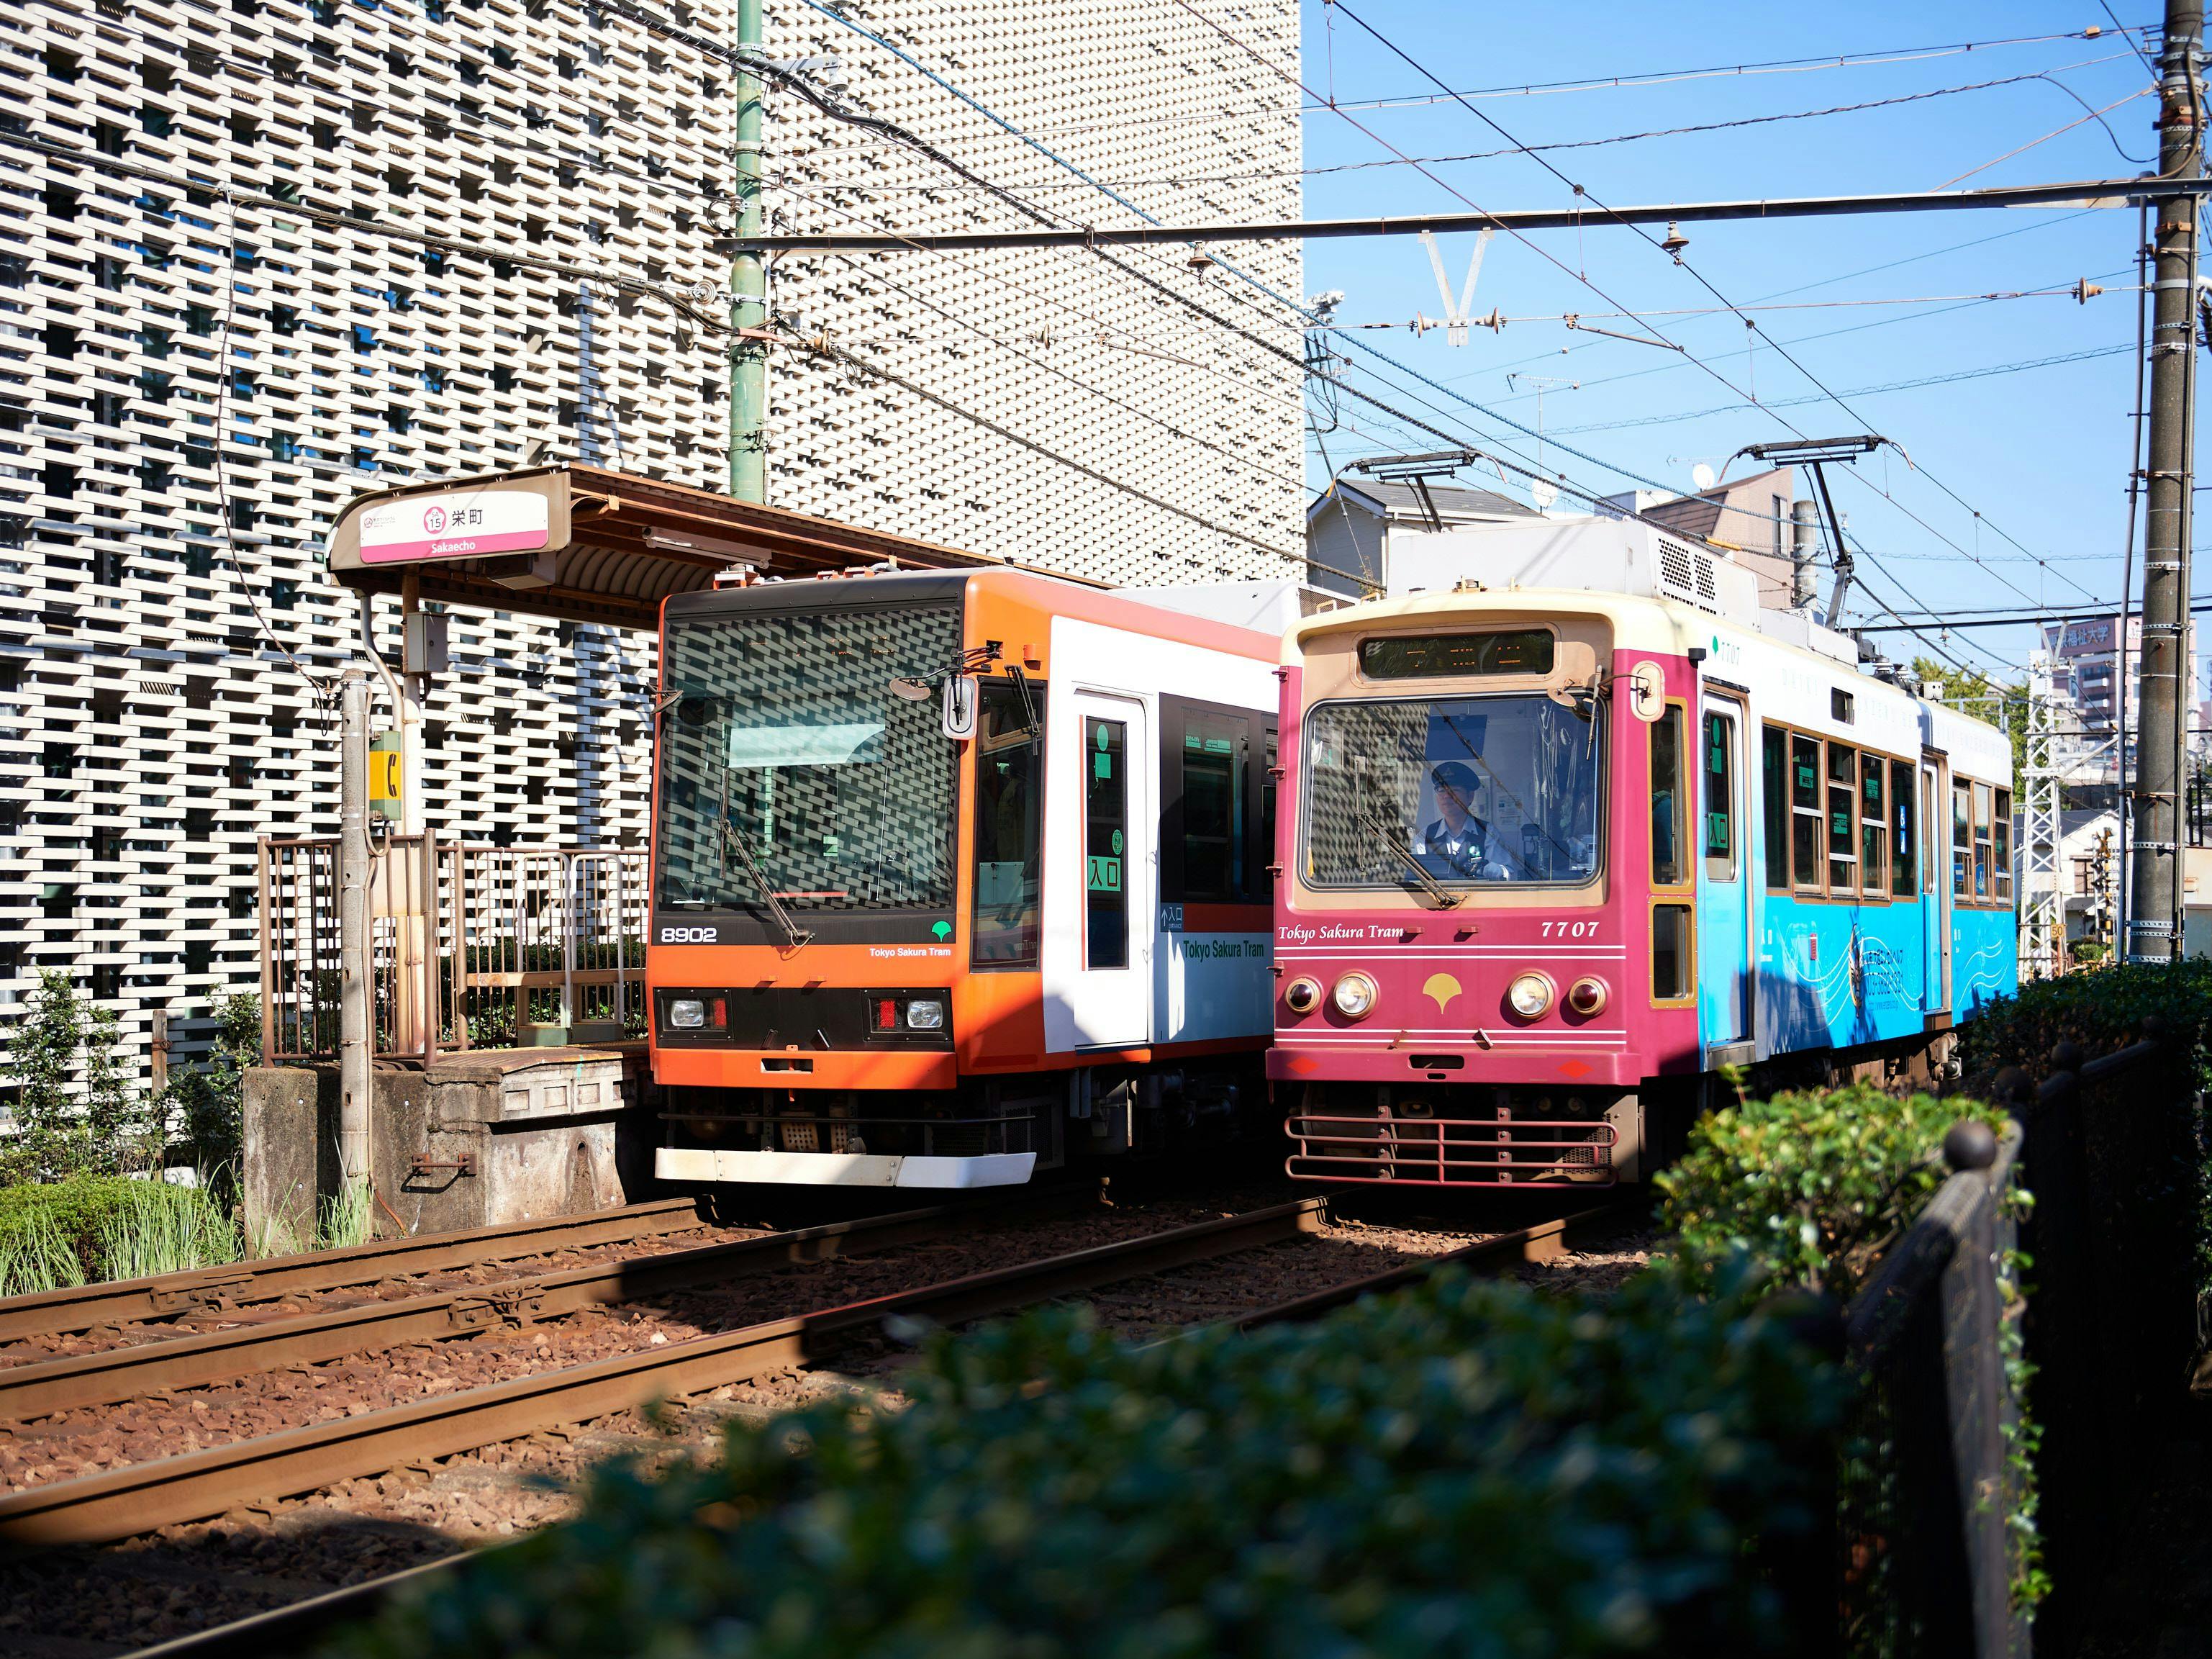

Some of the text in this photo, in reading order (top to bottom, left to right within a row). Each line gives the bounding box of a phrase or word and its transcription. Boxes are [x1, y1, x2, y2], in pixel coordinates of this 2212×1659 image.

[430, 518, 441, 528] 15
[452, 509, 483, 527] 栄町
[432, 541, 476, 553] Sakaecho
[1710, 815, 1726, 844] 入口
[1090, 859, 1118, 887] 入口
[1168, 907, 1182, 921] 入口
[661, 927, 717, 943] 8902
[1278, 923, 1403, 945] Tokyo Sakura Tram
[1541, 921, 1600, 937] 7707
[2052, 926, 2063, 936] 50
[869, 947, 951, 959] Tokyo Sakura Tram
[1183, 939, 1264, 963] Tokyo Sakura Tram
